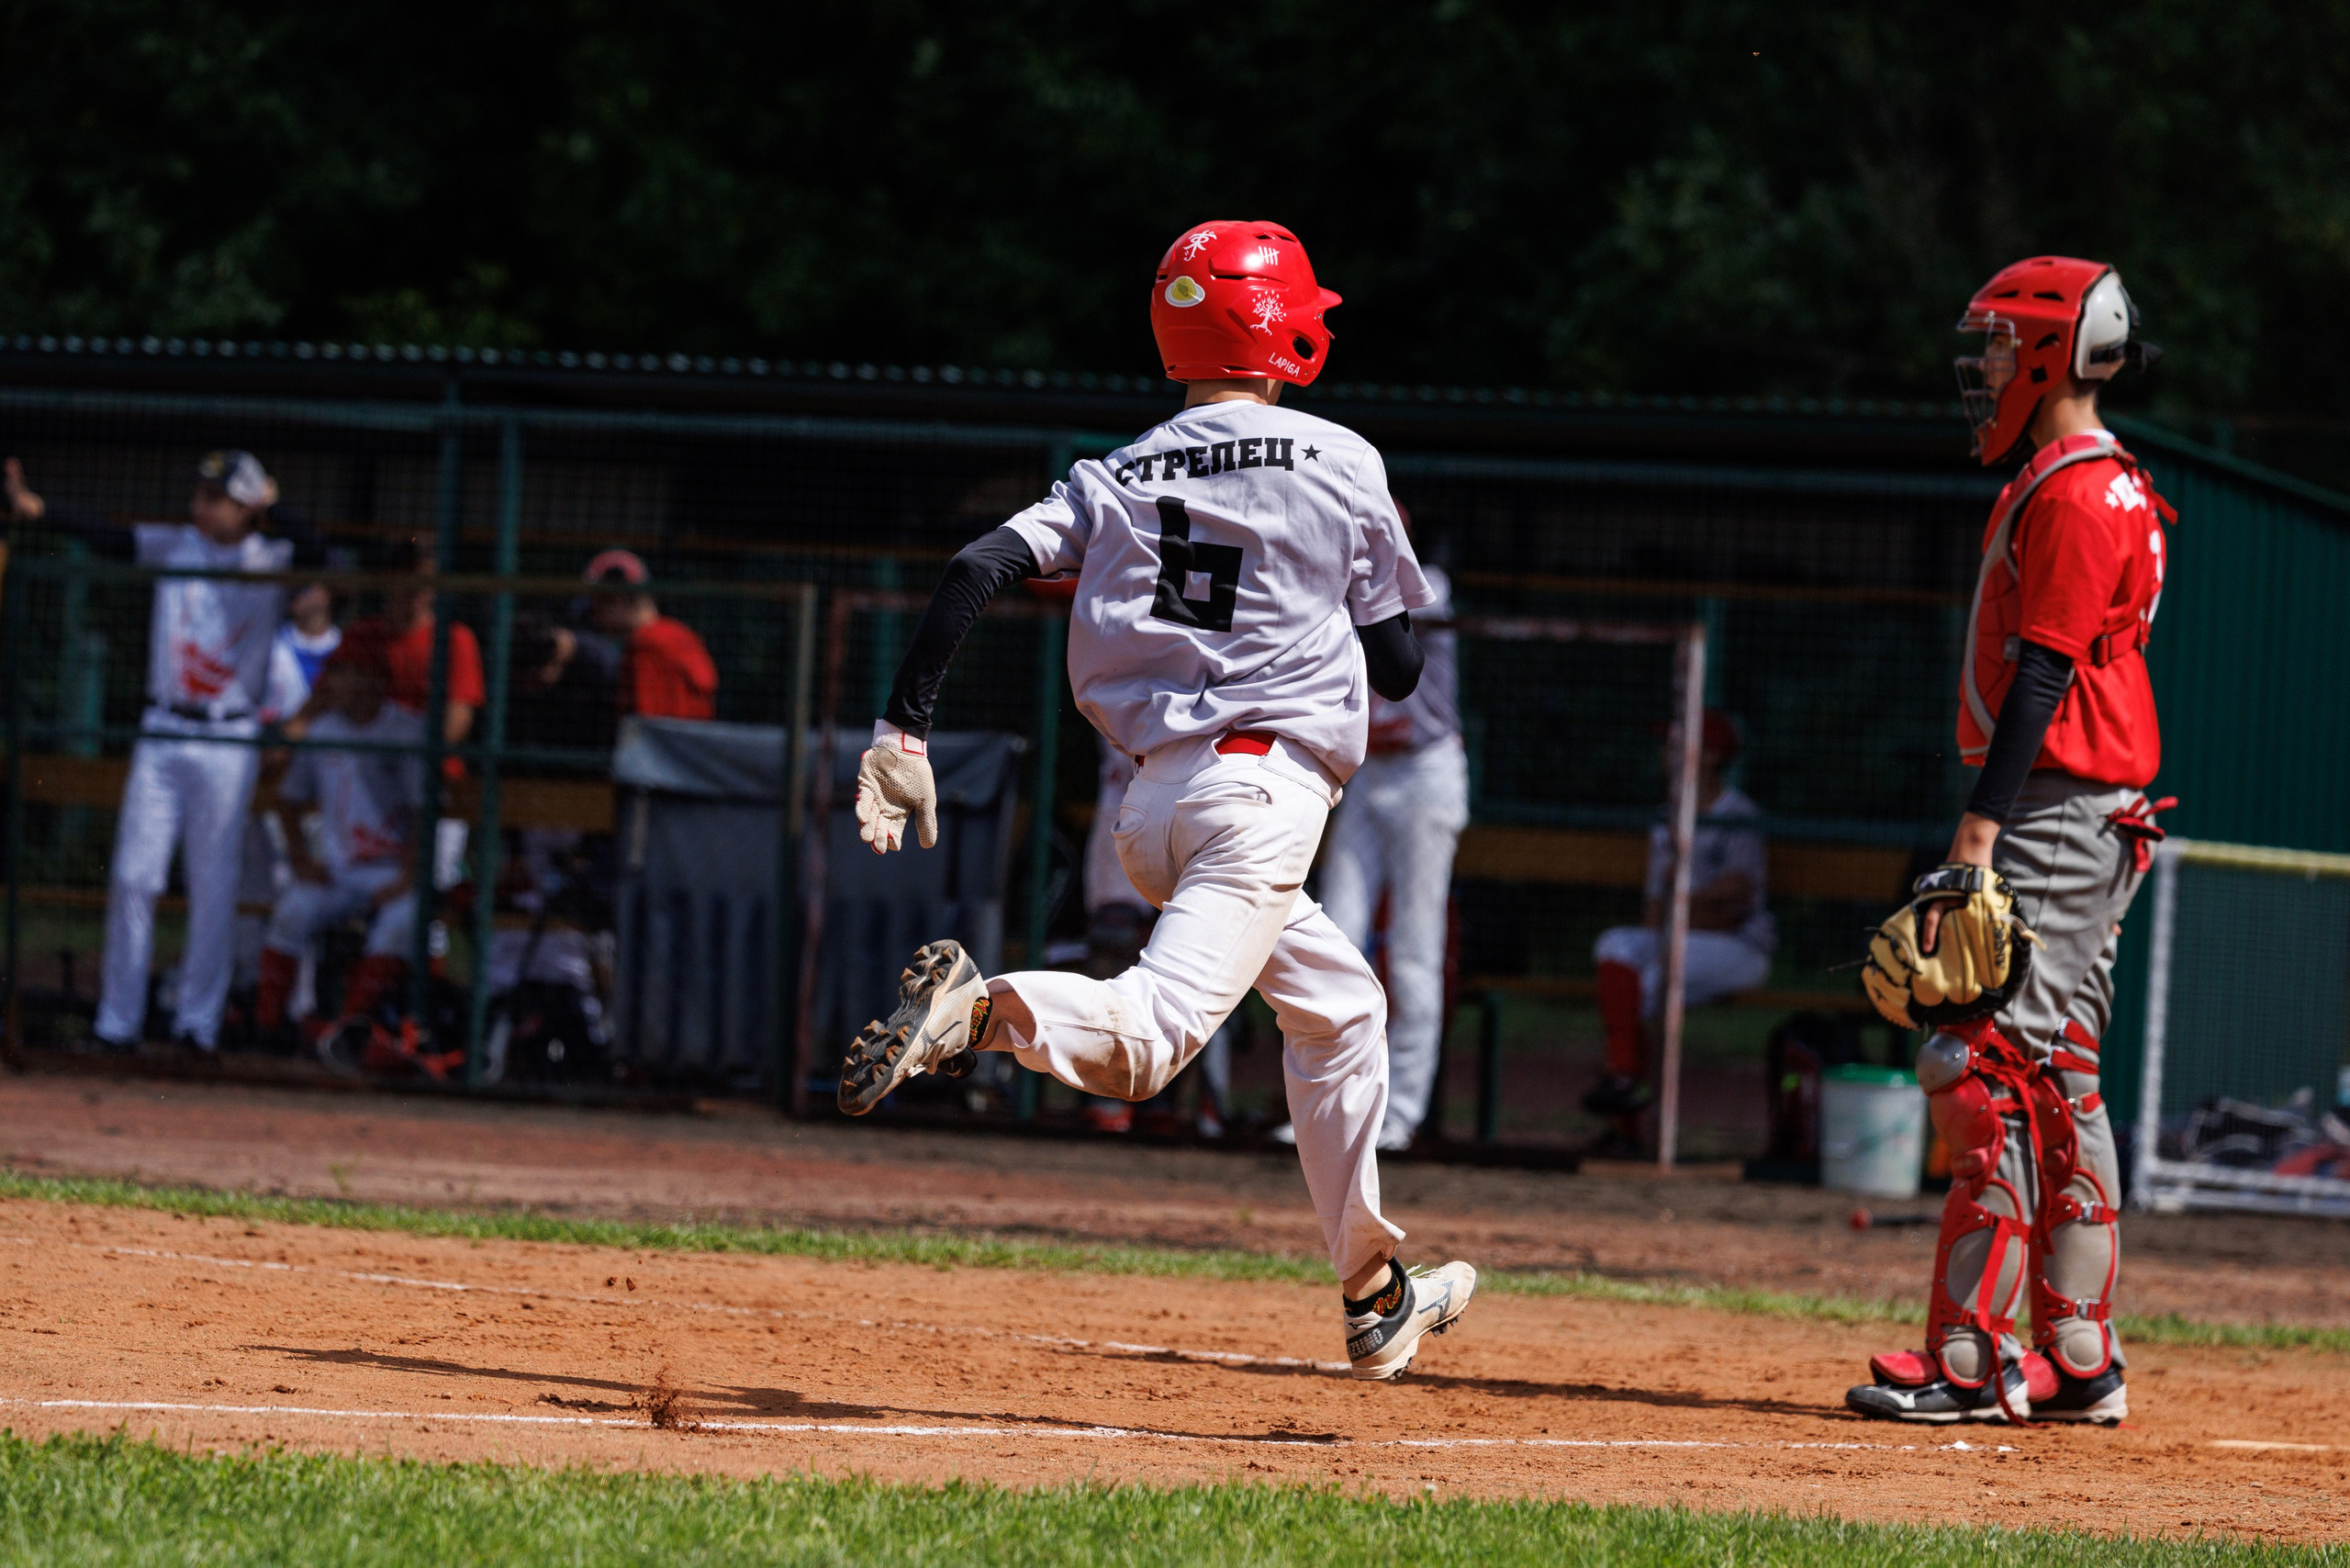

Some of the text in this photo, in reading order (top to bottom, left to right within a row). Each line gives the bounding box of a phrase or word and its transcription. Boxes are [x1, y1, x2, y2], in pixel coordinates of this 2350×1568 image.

[1268, 352, 1301, 377] LAPIGA
[1114, 437, 1294, 487] СТРЕЛЕЦ
[1149, 495, 1244, 633] 6
